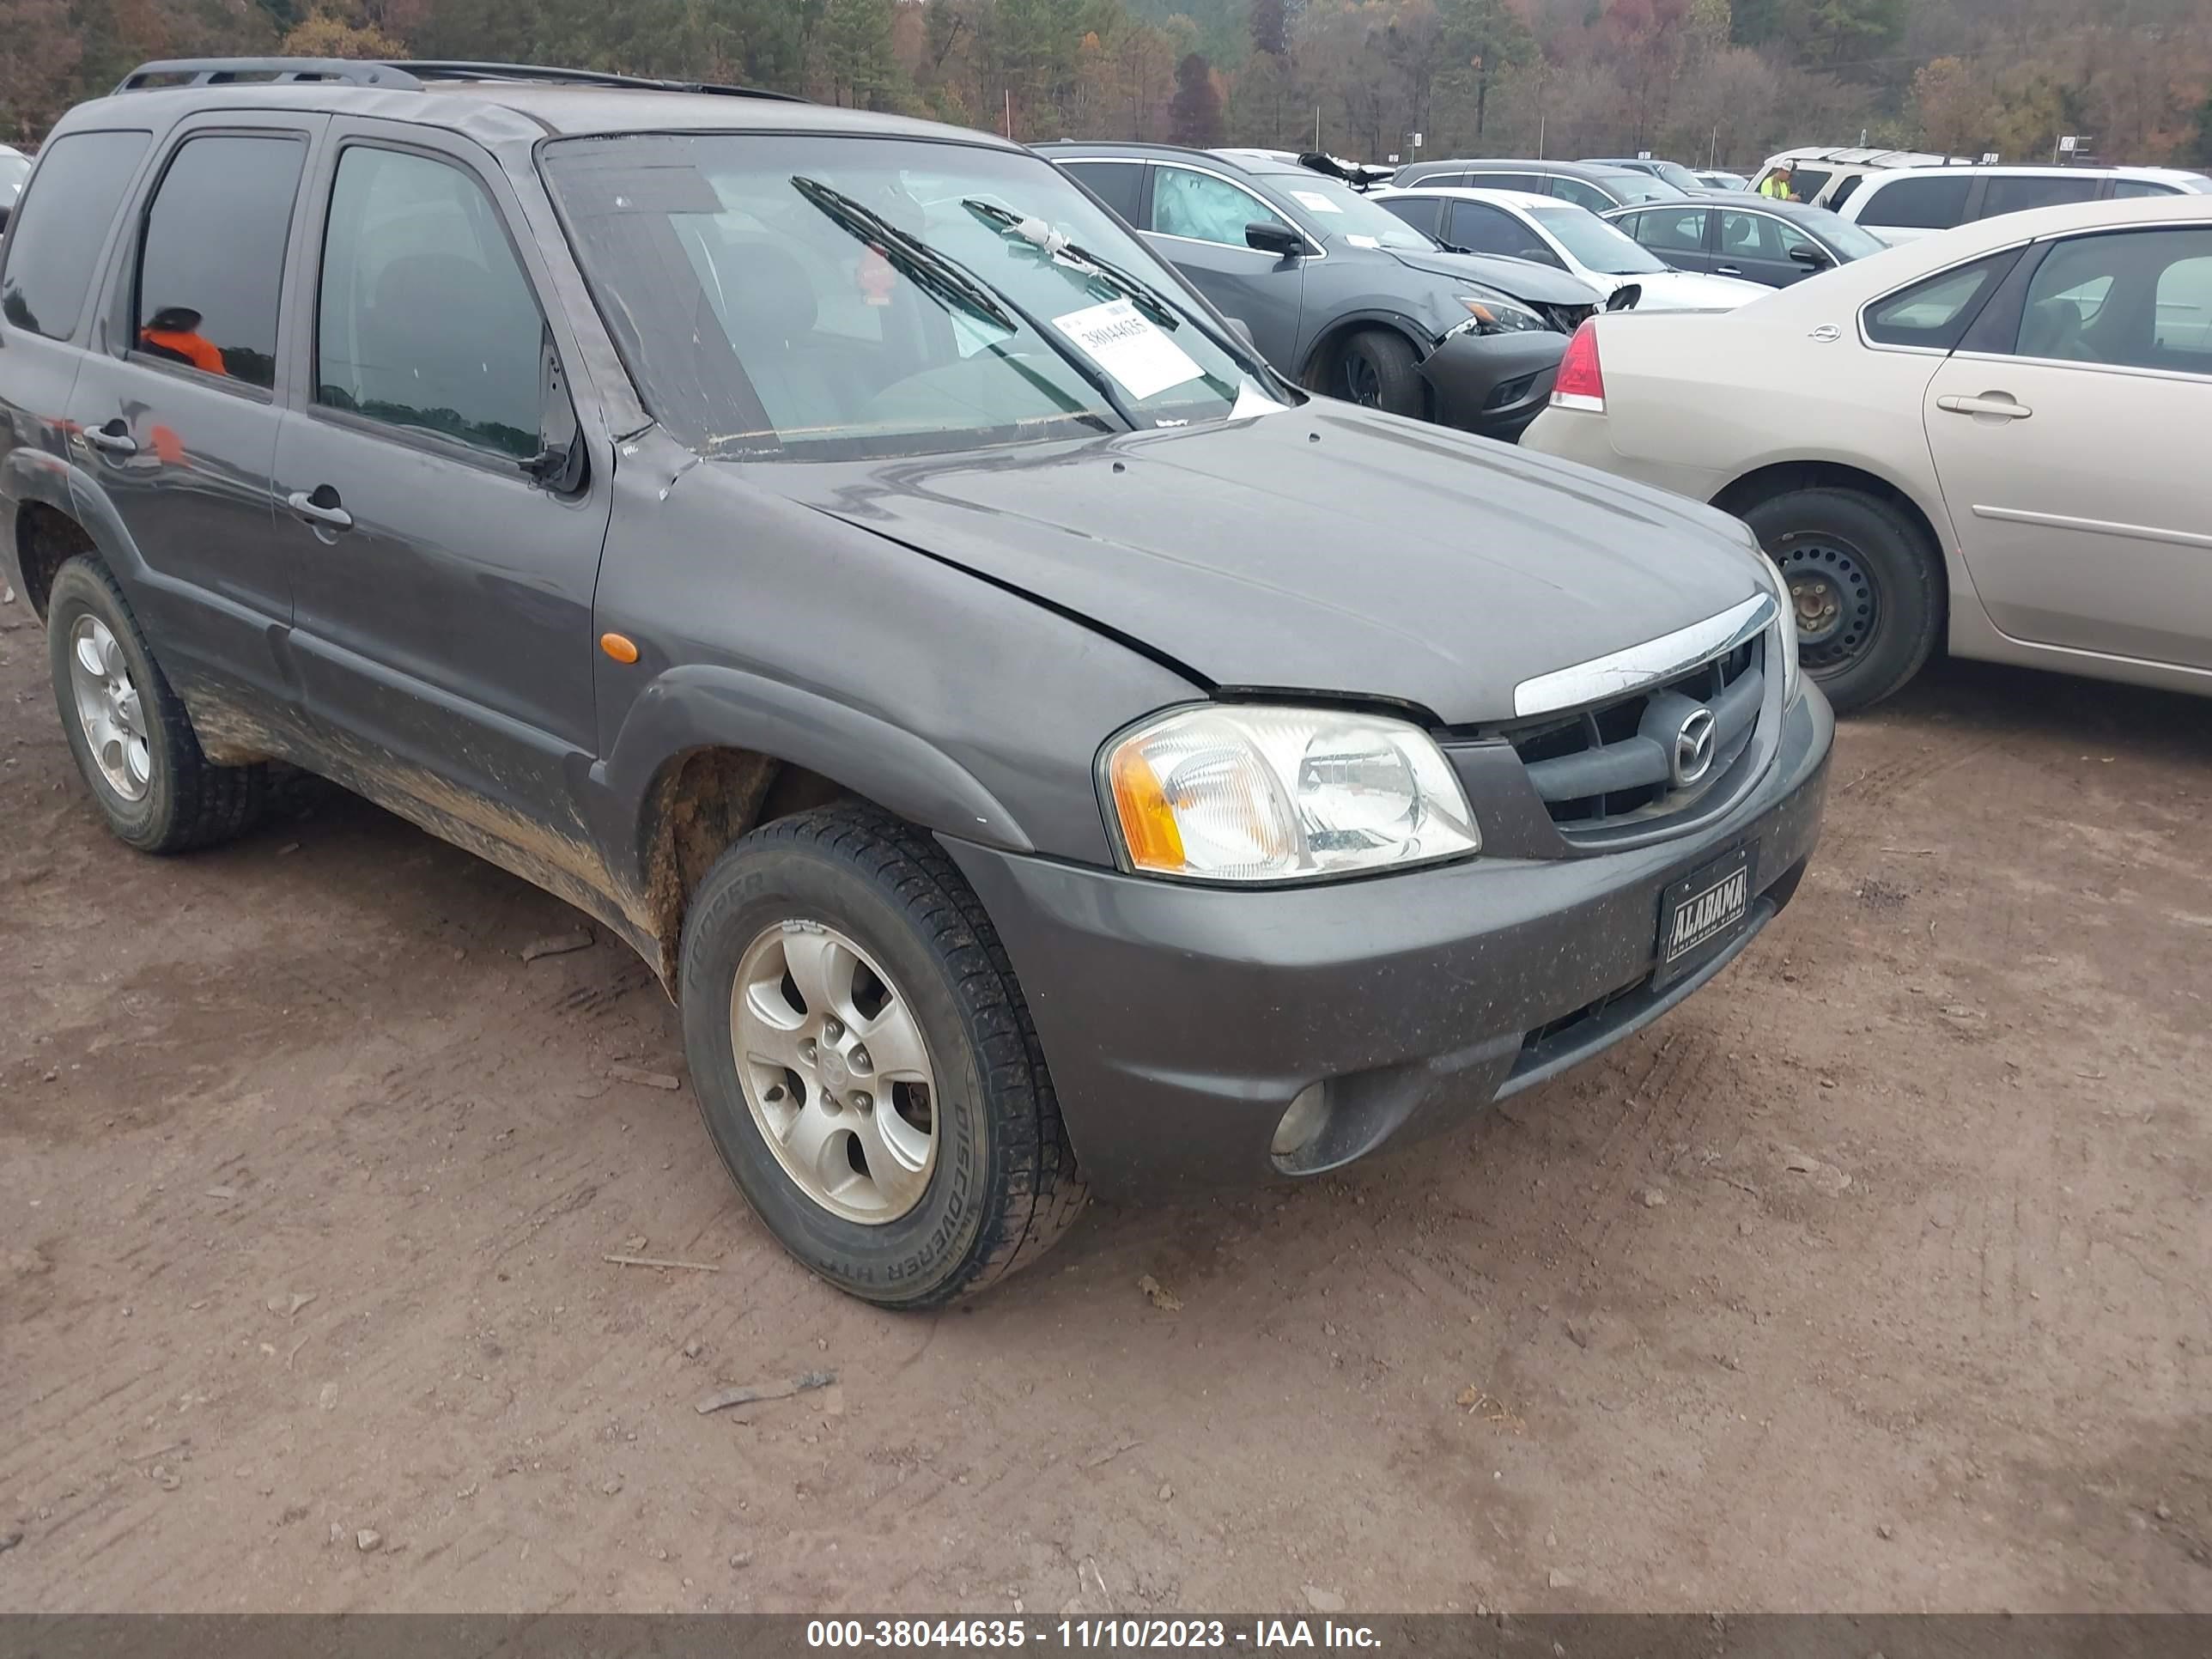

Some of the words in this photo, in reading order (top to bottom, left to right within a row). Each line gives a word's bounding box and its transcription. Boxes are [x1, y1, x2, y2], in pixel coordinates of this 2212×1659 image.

[1081, 317, 1148, 349] 38044635
[1674, 872, 1744, 946] ALABAMA
[886, 1103, 971, 1282] DISCOVERER
